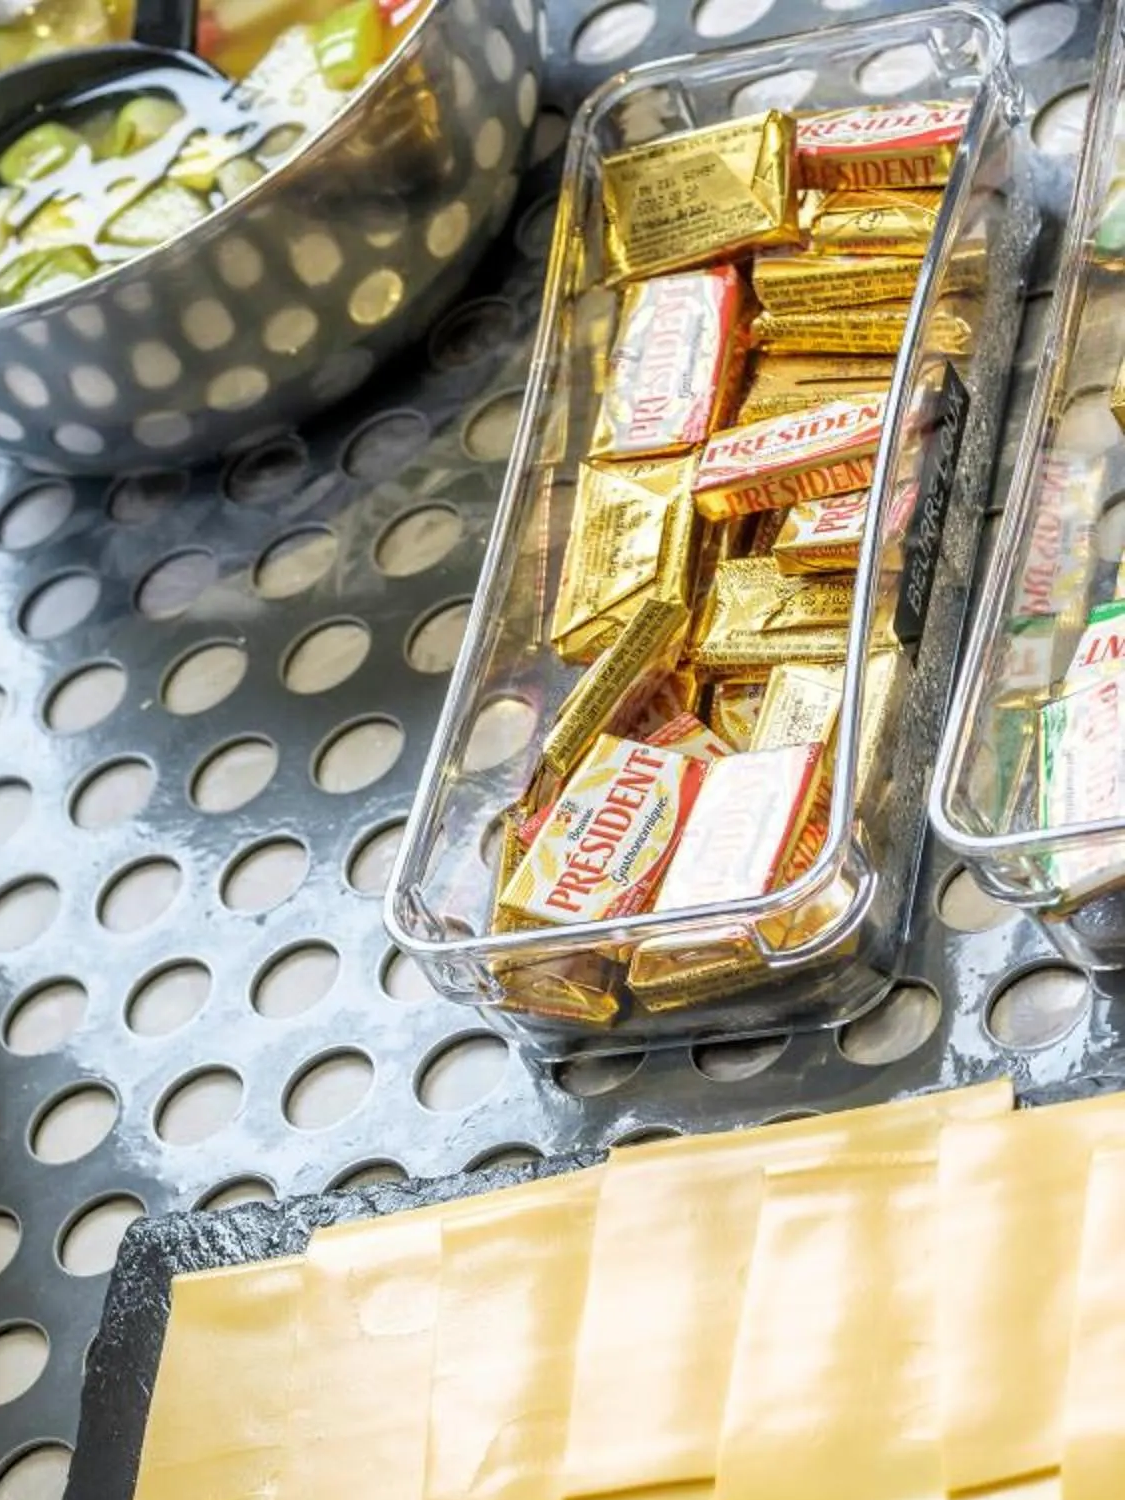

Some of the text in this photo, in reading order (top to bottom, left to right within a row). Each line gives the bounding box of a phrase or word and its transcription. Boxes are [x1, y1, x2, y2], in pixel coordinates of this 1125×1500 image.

[707, 402, 881, 464] PRÉSIDEN
[545, 748, 664, 913] PRÉSIDENT
[610, 795, 668, 887] Gastronomique
